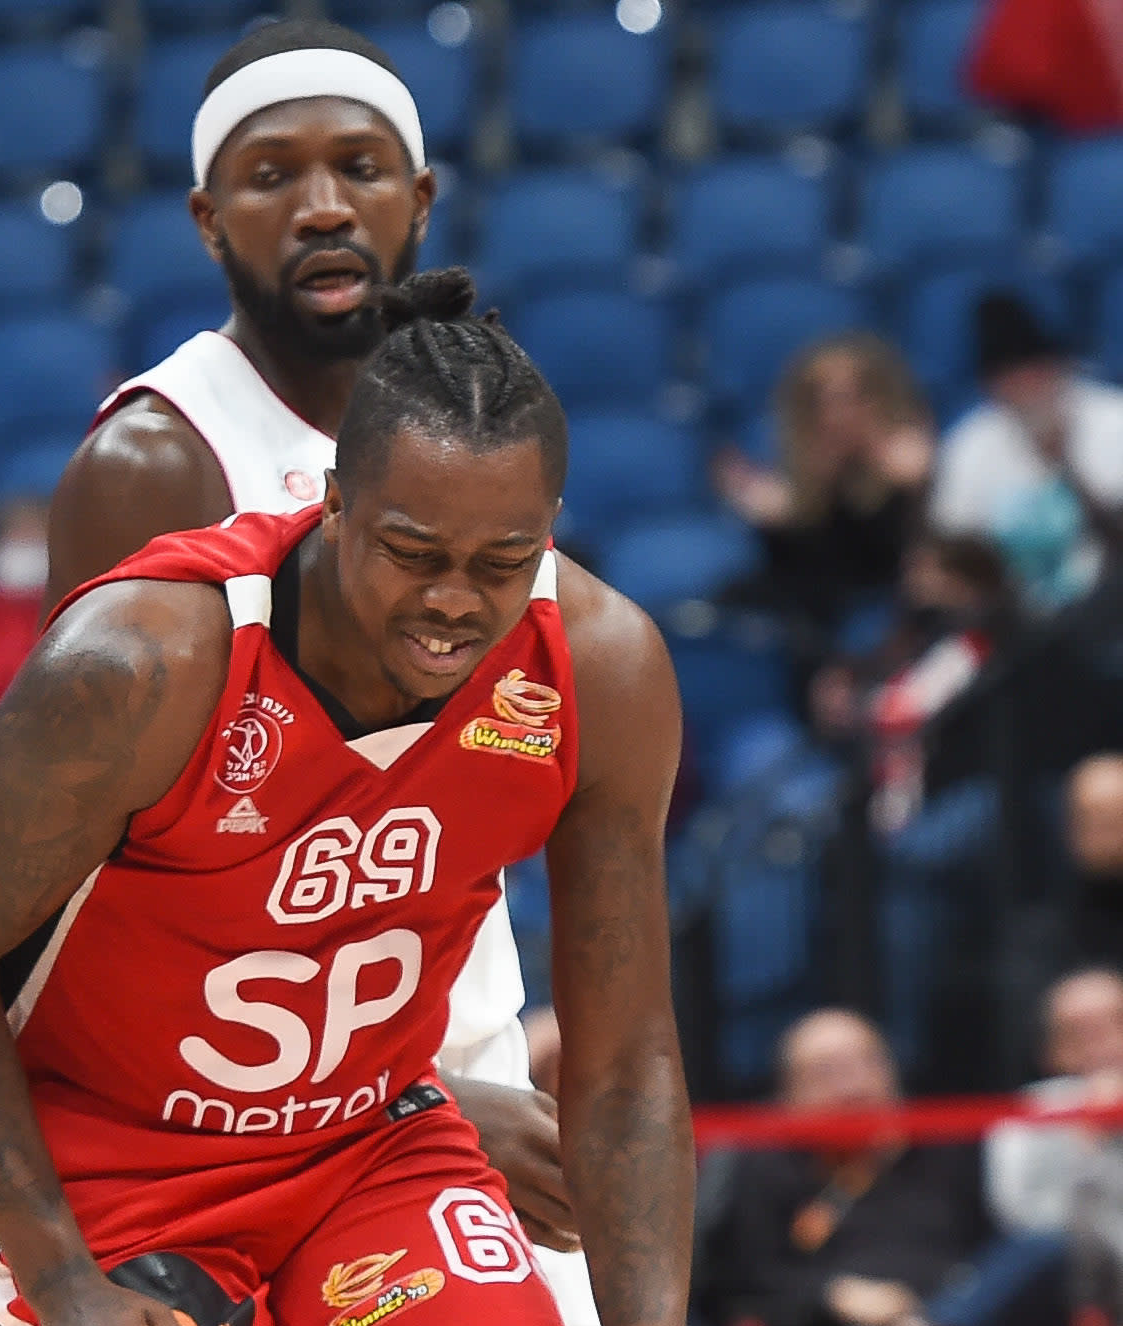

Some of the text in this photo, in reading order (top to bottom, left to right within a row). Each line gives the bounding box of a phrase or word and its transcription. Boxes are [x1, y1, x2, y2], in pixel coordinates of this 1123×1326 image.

[475, 726, 553, 756] Winner
[266, 806, 442, 925] 69
[179, 928, 422, 1093] SP
[428, 1186, 535, 1284] 6
